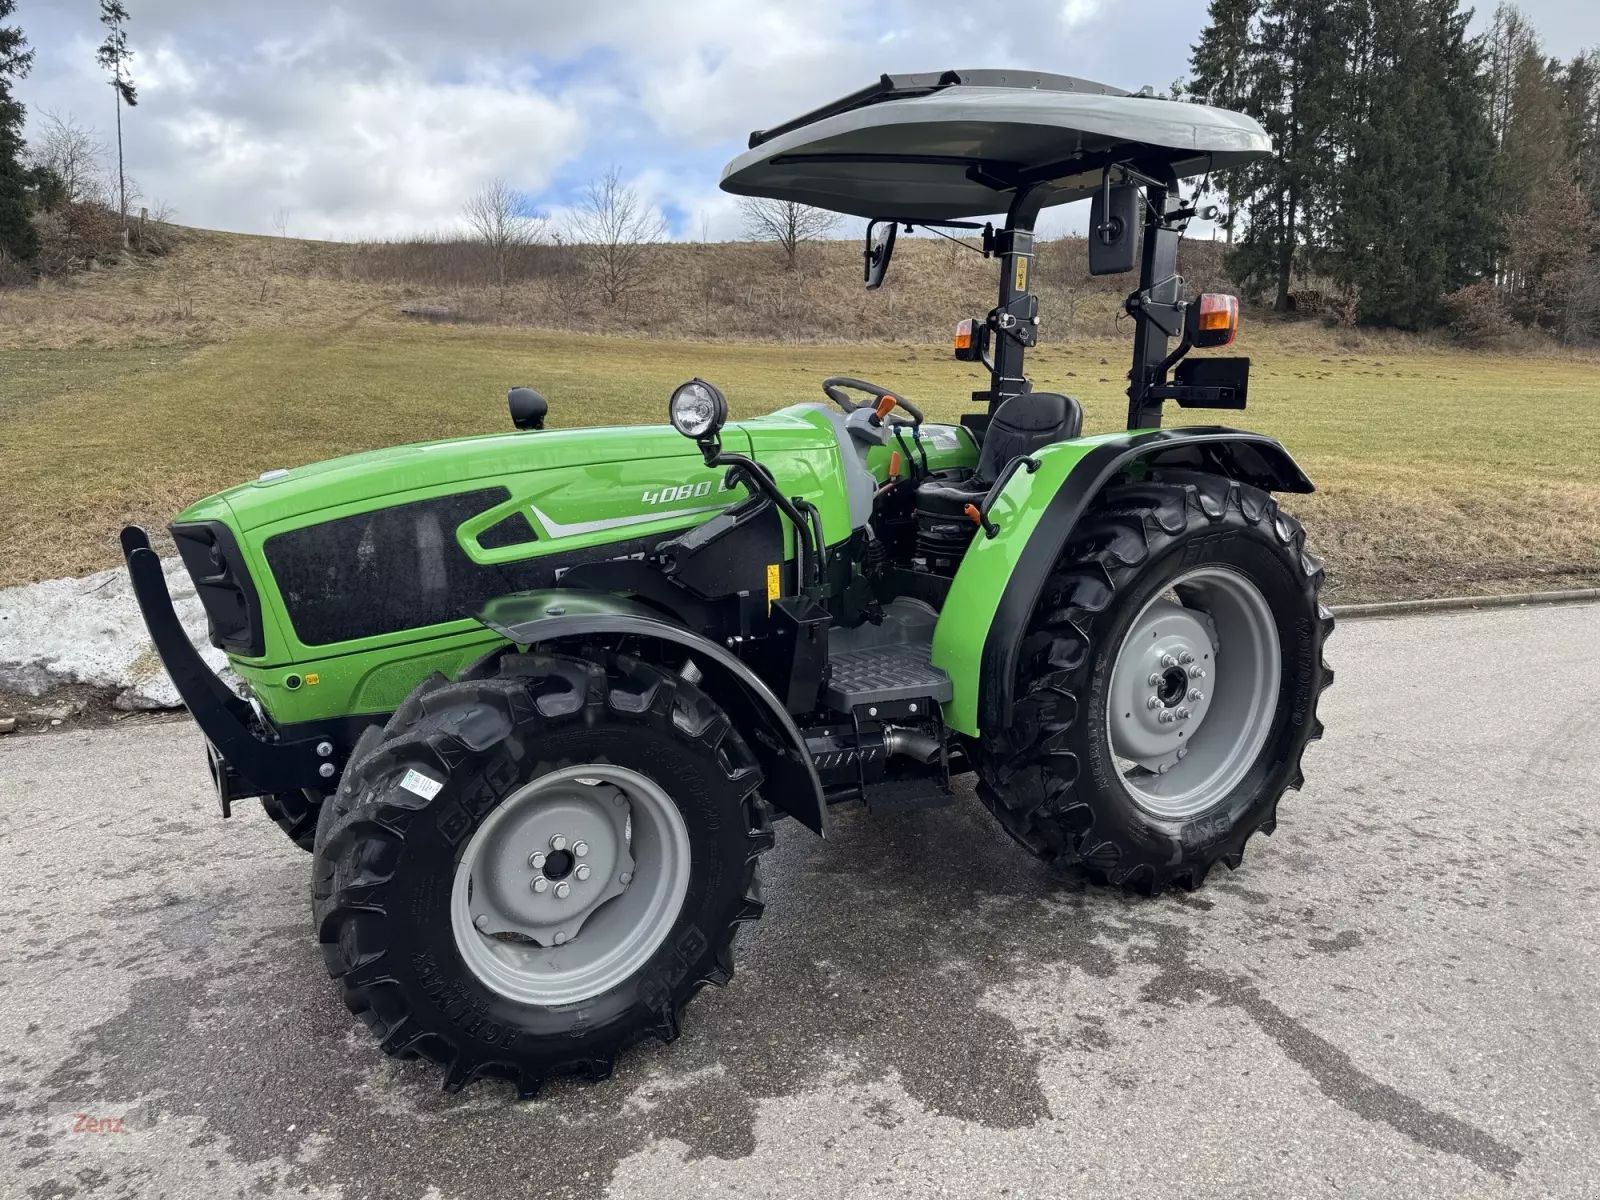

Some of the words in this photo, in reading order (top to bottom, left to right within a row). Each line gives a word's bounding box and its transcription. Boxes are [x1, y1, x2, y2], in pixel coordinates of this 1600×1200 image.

[642, 481, 712, 505] 4080
[438, 761, 519, 843] BKT
[409, 948, 521, 1050] AGRIMAX
